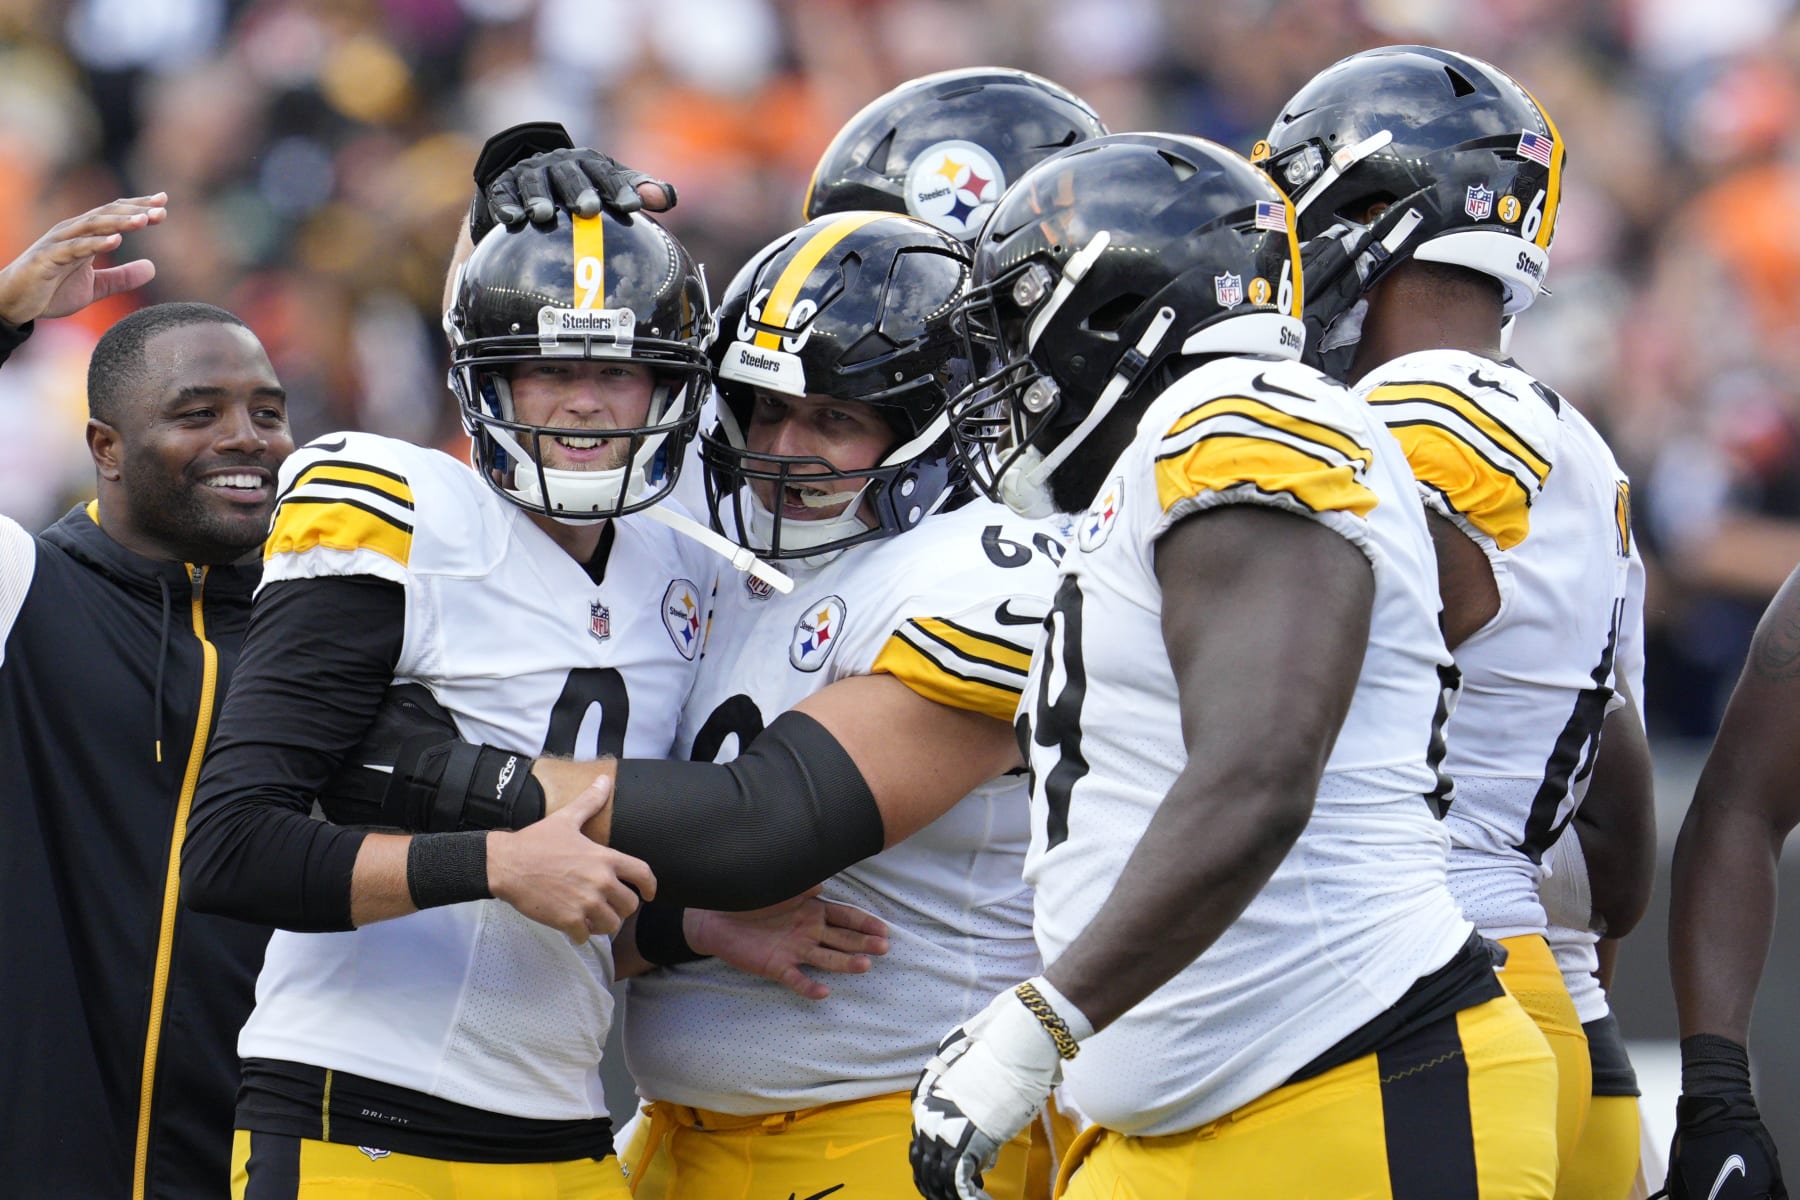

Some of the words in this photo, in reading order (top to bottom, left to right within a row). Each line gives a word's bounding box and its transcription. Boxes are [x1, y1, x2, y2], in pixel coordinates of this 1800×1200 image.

[918, 186, 951, 202] Steelers
[1469, 199, 1488, 215] NFL
[1503, 198, 1516, 221] 3
[1521, 189, 1546, 242] 6
[576, 257, 602, 309] 9
[1255, 280, 1266, 303] 3
[1277, 259, 1293, 315] 6
[1220, 289, 1239, 302] NFL
[562, 312, 611, 329] Steelers
[740, 350, 780, 372] Steelers
[593, 616, 609, 634] NFL
[360, 1108, 408, 1125] DRI-FIT
